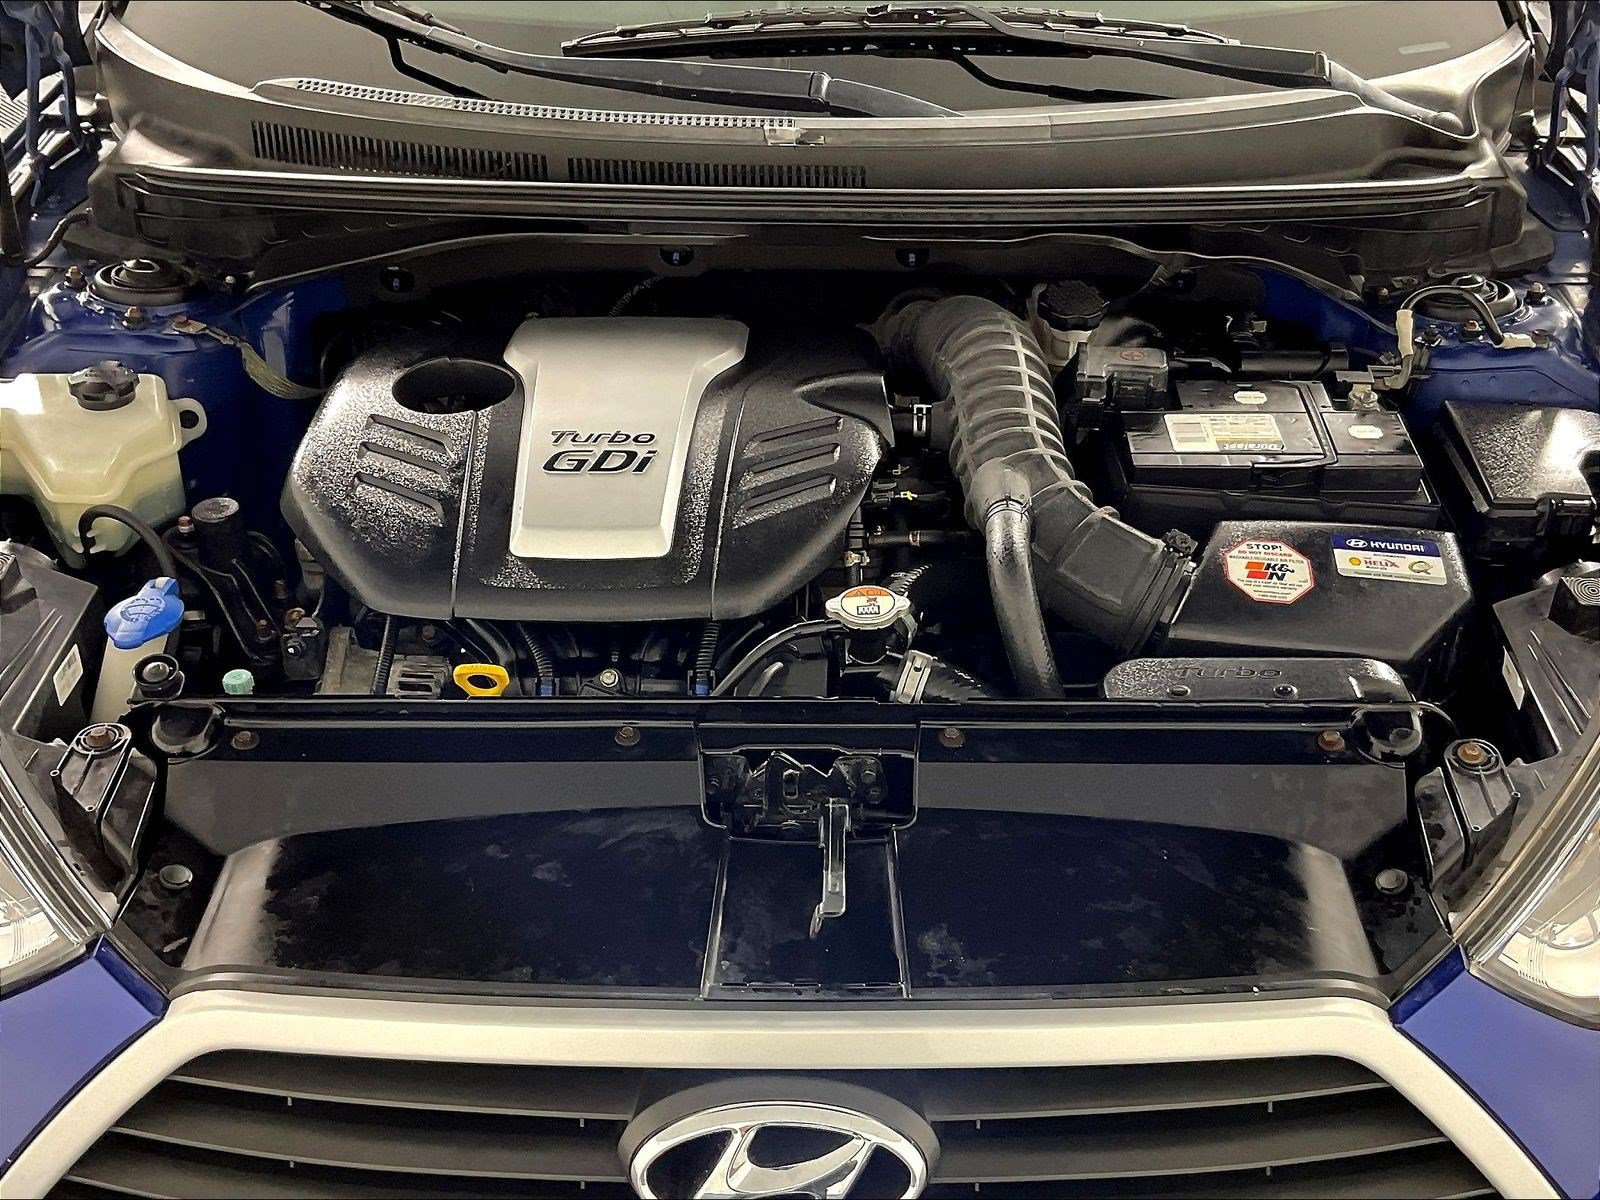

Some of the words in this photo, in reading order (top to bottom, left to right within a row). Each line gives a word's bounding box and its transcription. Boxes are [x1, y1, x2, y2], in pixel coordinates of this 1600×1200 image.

[551, 430, 656, 446] Turbo
[542, 449, 659, 474] GDi
[1246, 543, 1283, 551] STOP!
[1369, 540, 1425, 552] HYUNDAI
[1364, 559, 1400, 569] HELIX
[1177, 666, 1282, 679] Turbo
